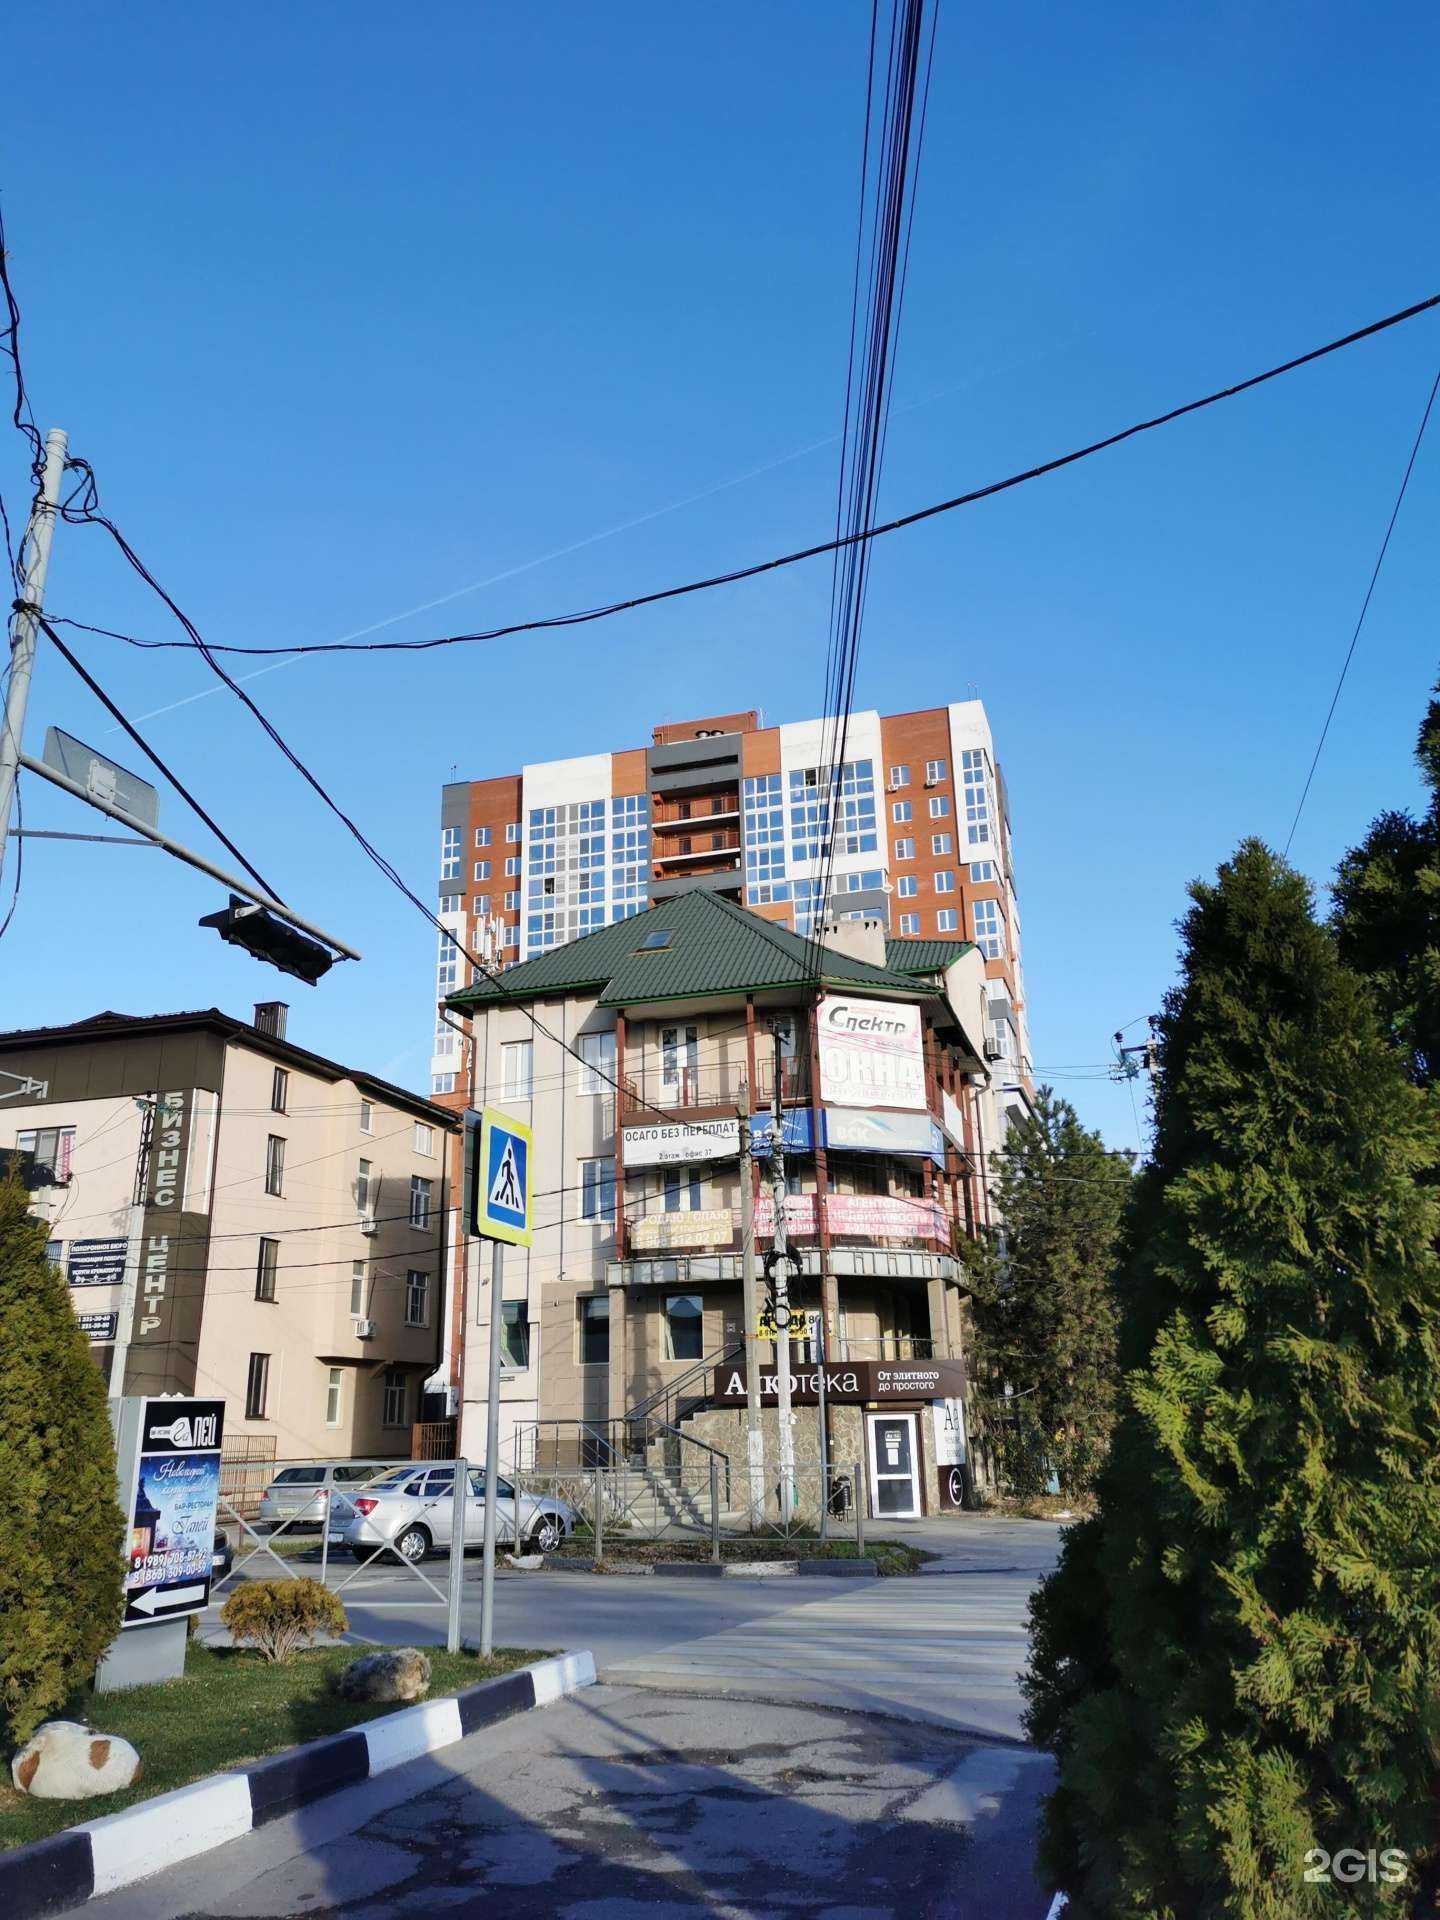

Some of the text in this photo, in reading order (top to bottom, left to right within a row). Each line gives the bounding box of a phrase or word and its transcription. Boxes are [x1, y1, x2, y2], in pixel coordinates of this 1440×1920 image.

[829, 1006, 907, 1034] Спектр
[625, 1129, 658, 1142] ОСАГО
[661, 1127, 680, 1139] БЕЗ
[154, 1092, 184, 1207] БИЗНЕС
[139, 1235, 169, 1335] ЦЕНТР
[877, 1371, 892, 1381] От
[892, 1370, 940, 1381] элитного
[878, 1380, 936, 1393] до простого
